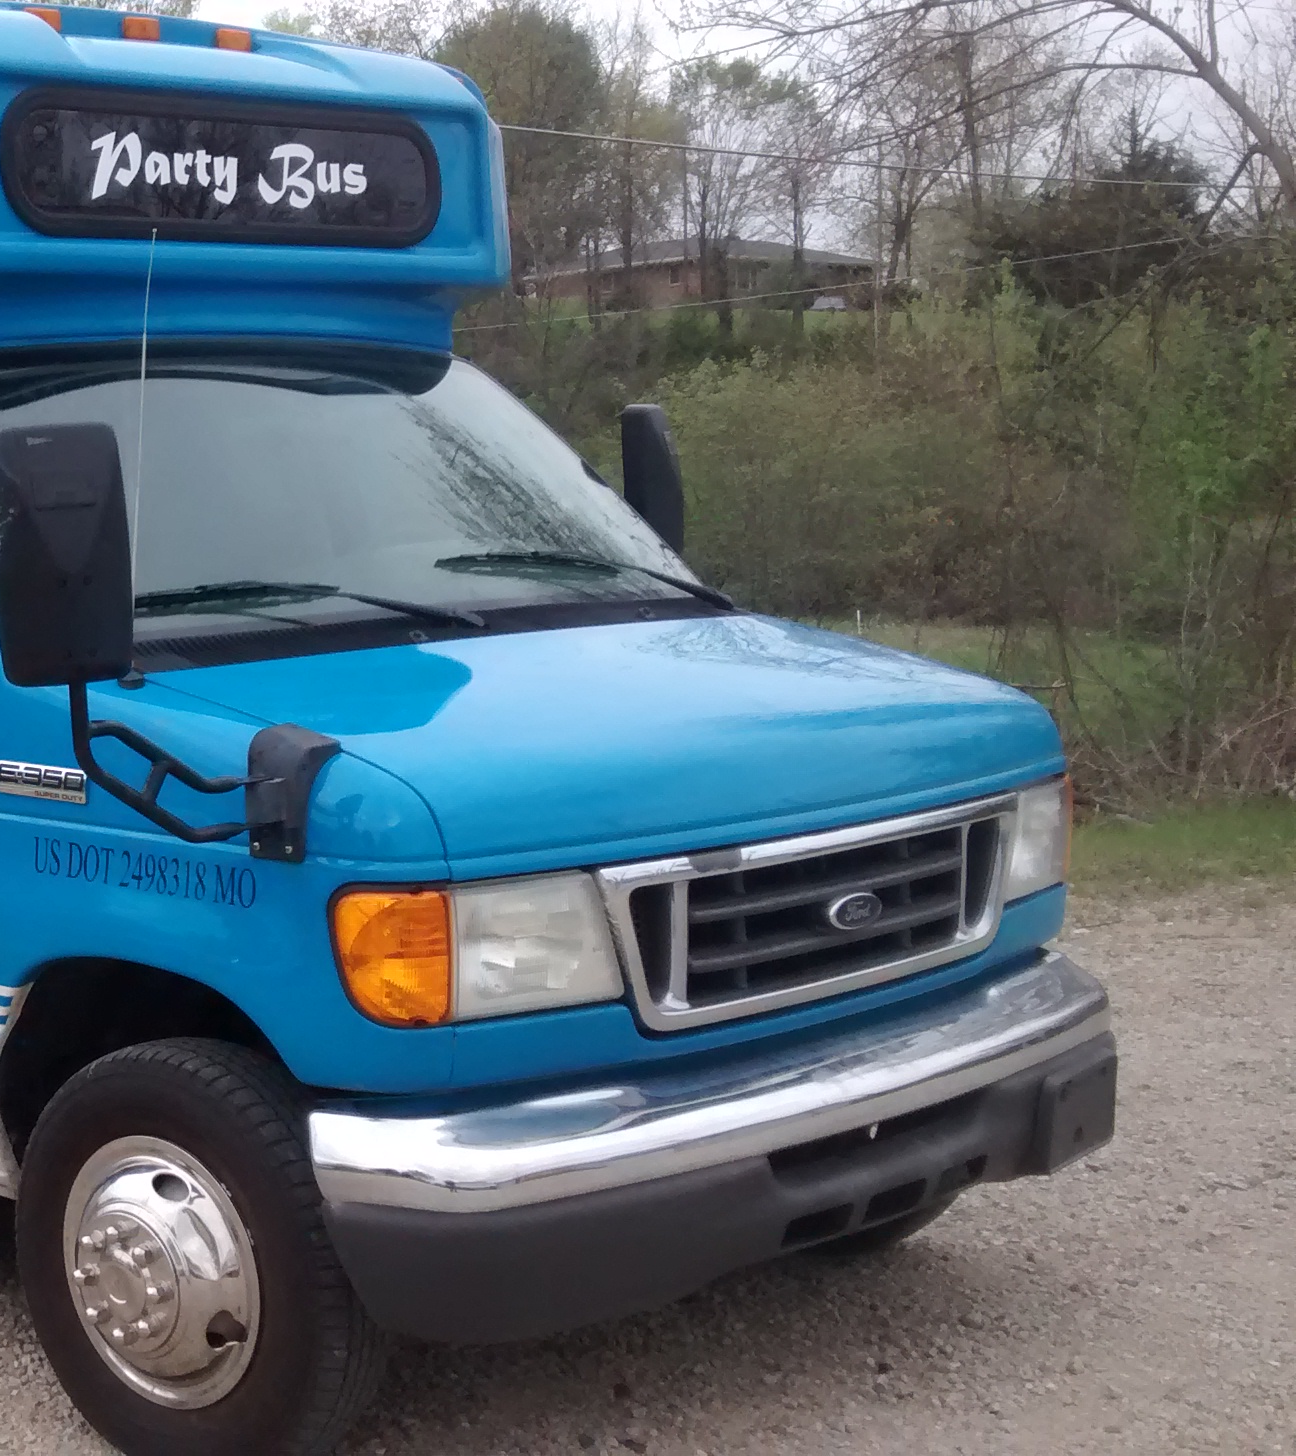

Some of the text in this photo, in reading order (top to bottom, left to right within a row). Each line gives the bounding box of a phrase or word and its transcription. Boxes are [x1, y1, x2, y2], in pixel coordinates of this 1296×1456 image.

[91, 131, 368, 209] Party Bus
[34, 790, 83, 802] SUPER DUTY
[34, 837, 256, 908] US DOT 2498318 MO
[845, 901, 871, 921] Ford
